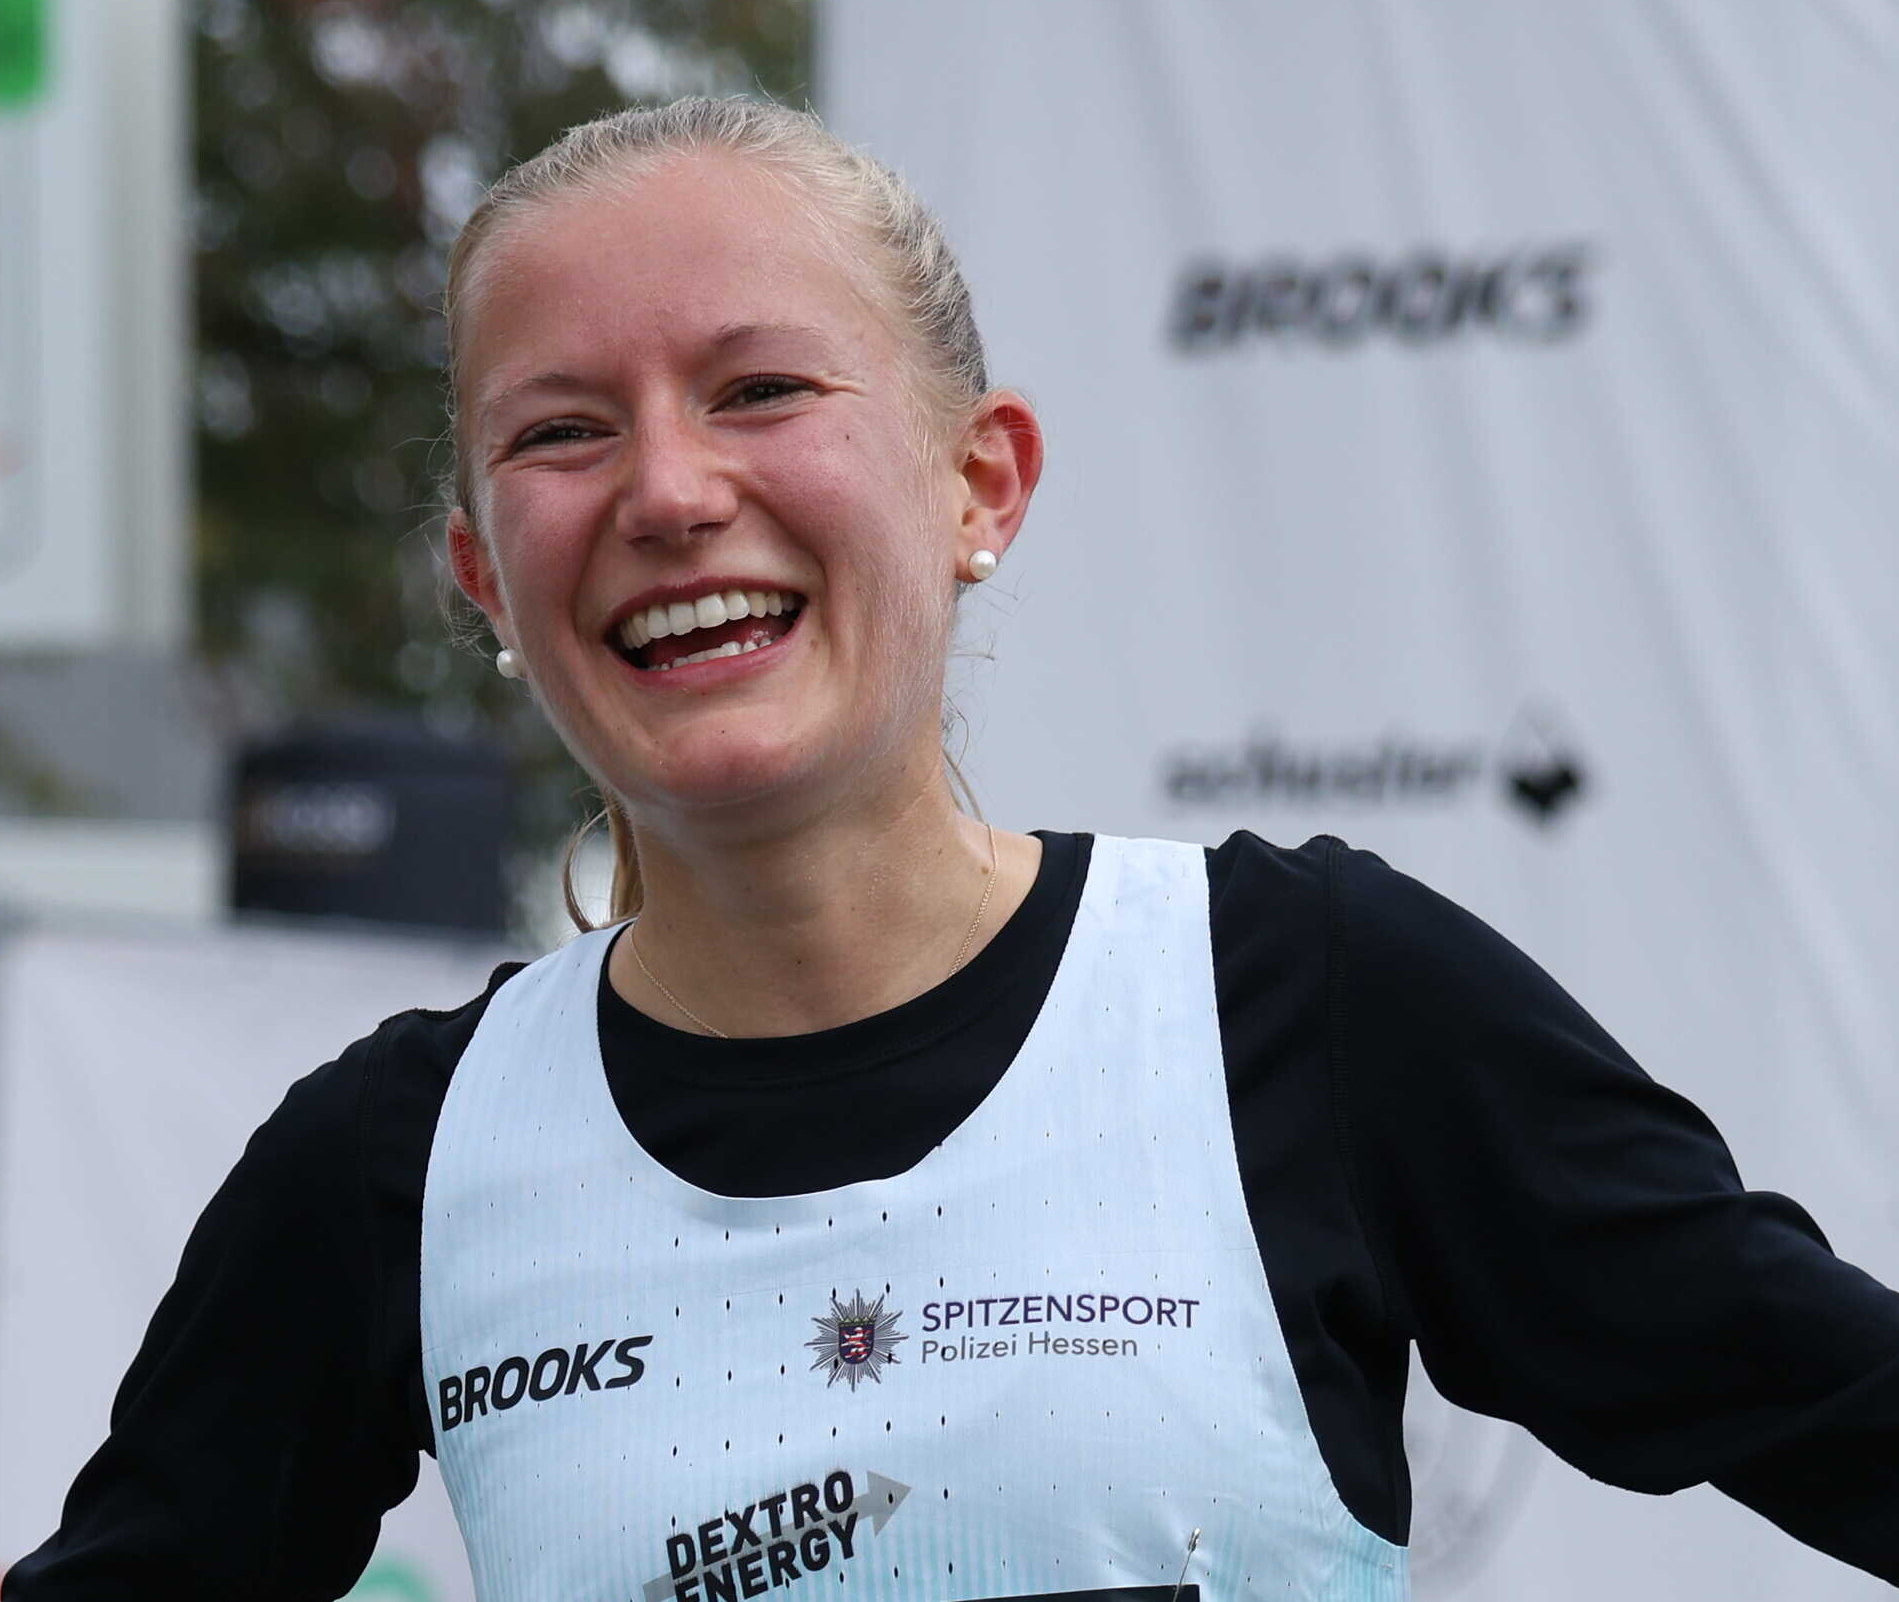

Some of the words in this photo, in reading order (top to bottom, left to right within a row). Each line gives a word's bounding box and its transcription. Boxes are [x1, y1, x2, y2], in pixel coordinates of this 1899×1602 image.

[1168, 245, 1591, 353] BROOKS
[921, 1294, 1201, 1332] SPITZENSPORT
[921, 1335, 1018, 1364] Polizei
[1027, 1330, 1139, 1358] Hessen
[439, 1335, 654, 1432] BROOKS
[664, 1468, 856, 1578] DEXTRO
